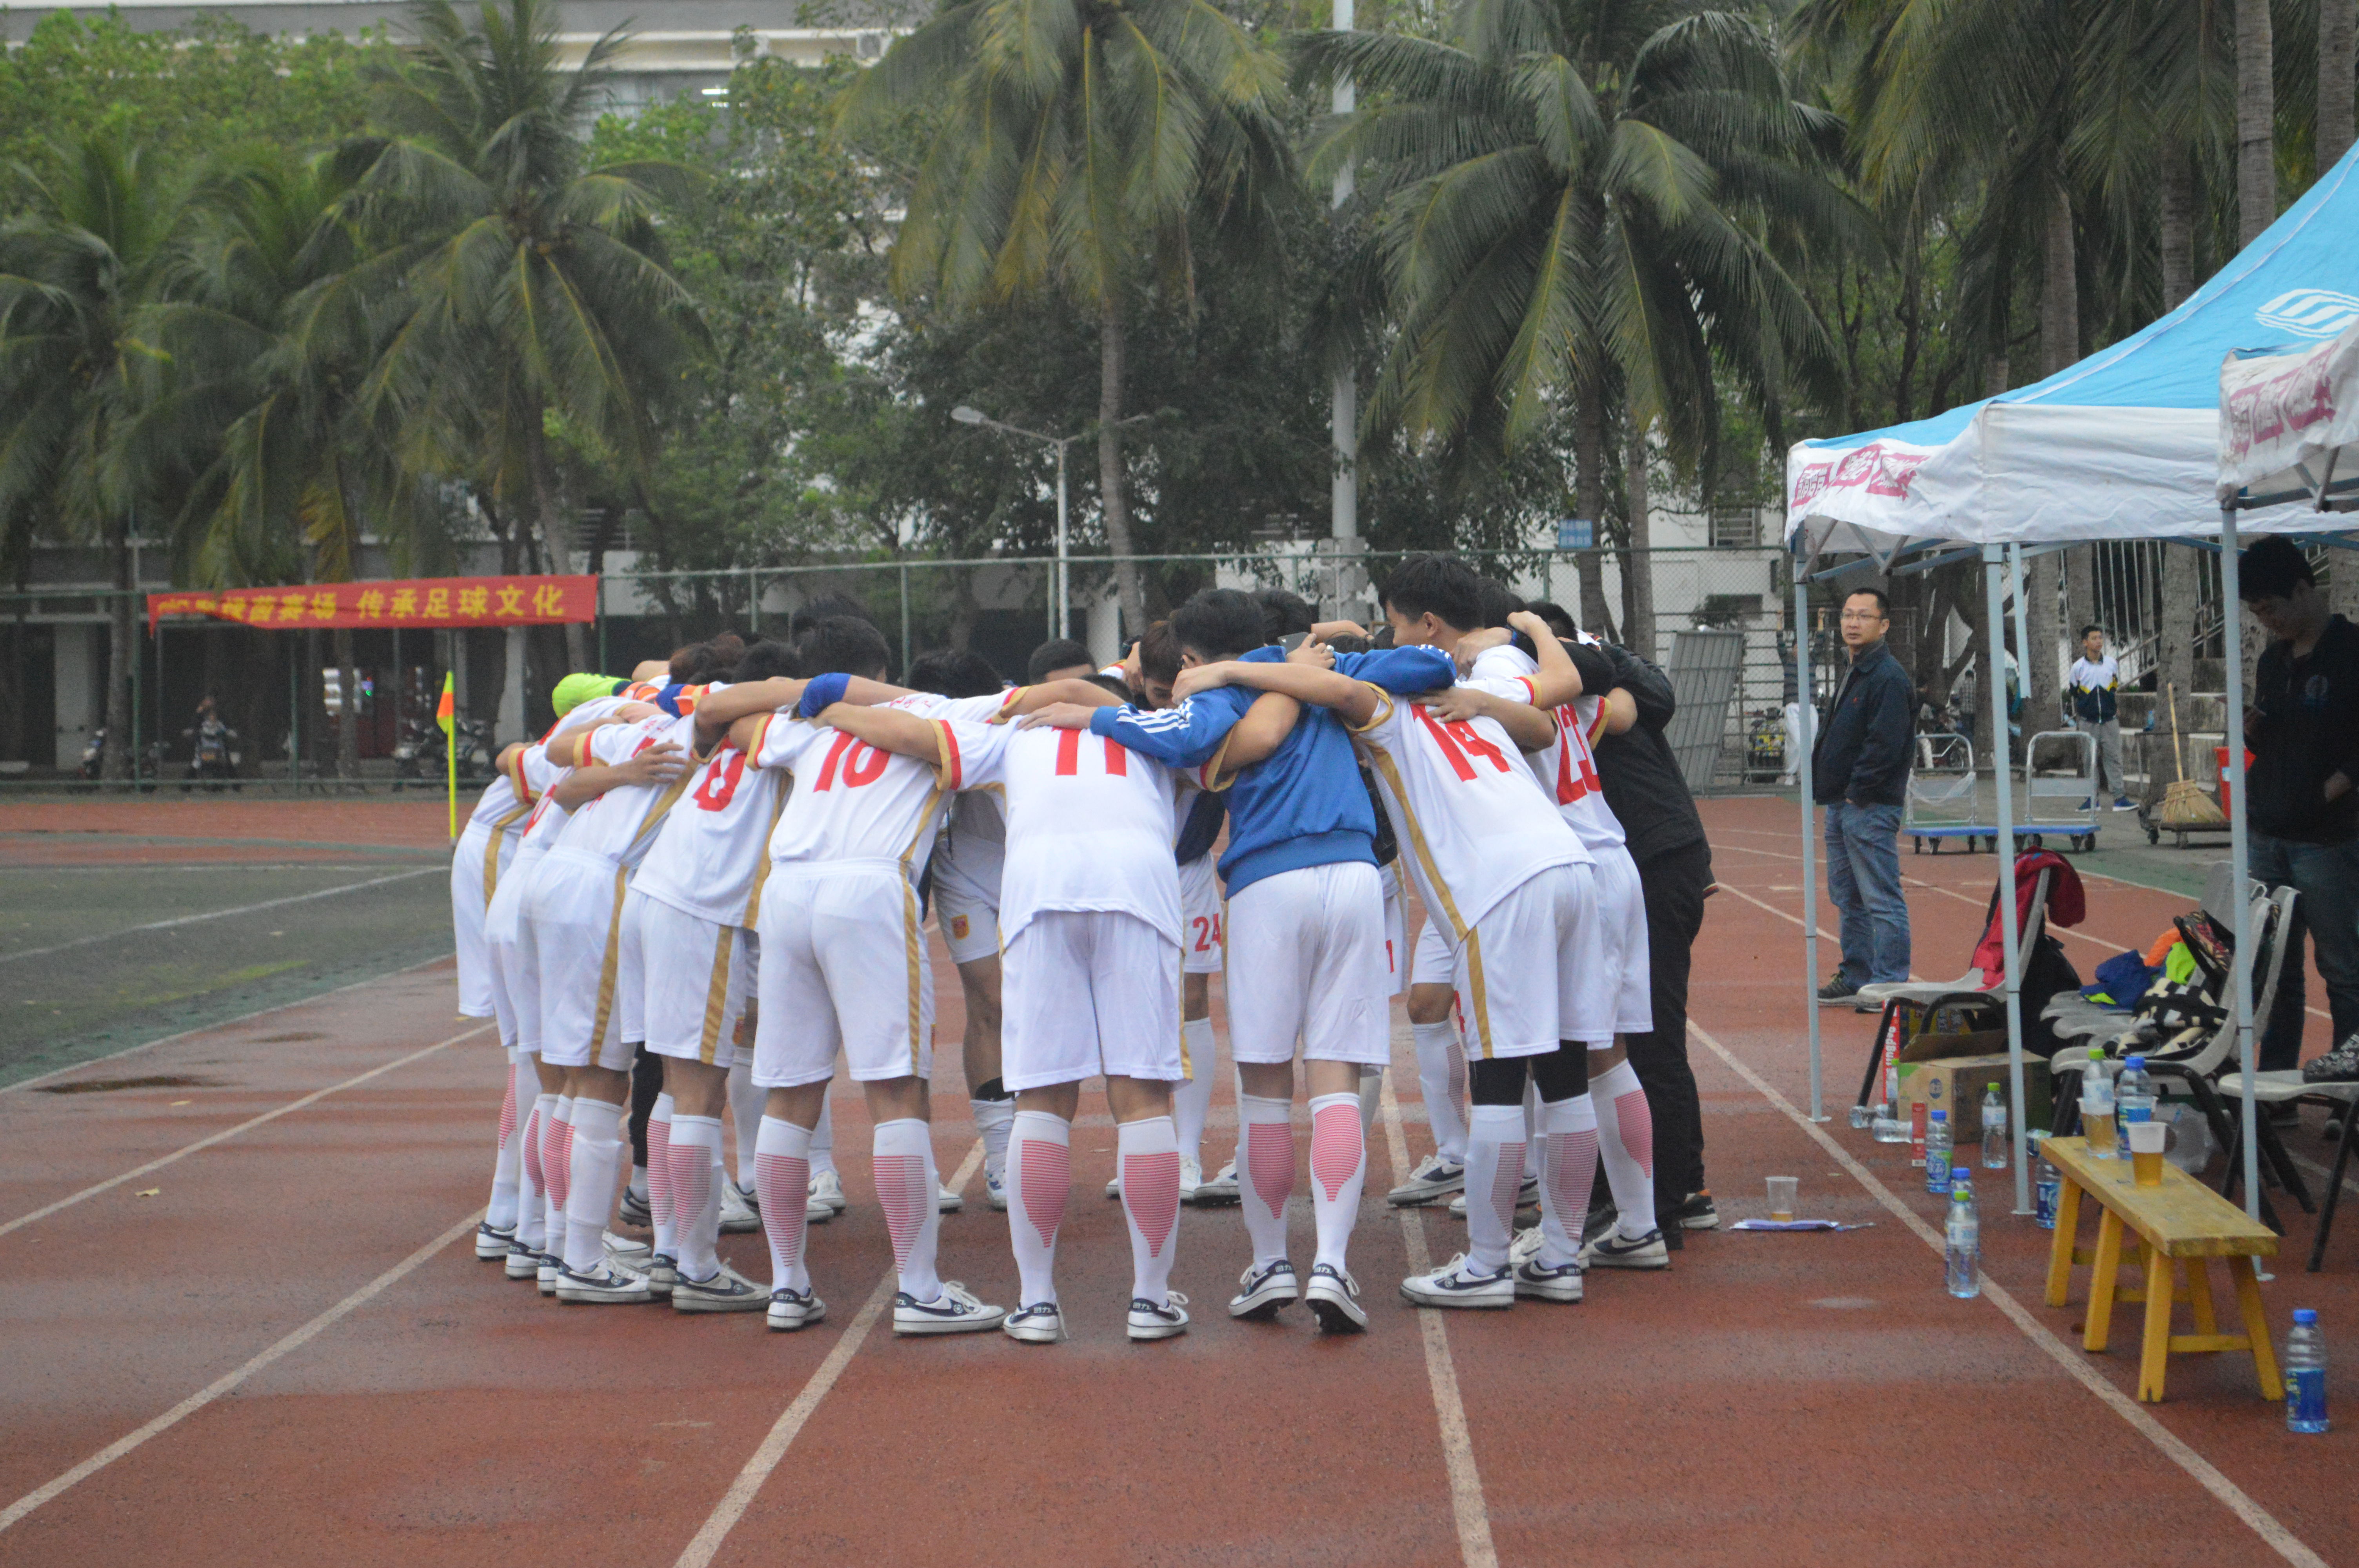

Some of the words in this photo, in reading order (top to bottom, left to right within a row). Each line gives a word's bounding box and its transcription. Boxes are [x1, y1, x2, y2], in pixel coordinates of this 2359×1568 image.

[357, 584, 564, 619] 传承足球文化
[813, 726, 892, 793] 10
[1051, 726, 1127, 777] 11
[1410, 704, 1512, 782] 14
[1192, 913, 1222, 952] 24
